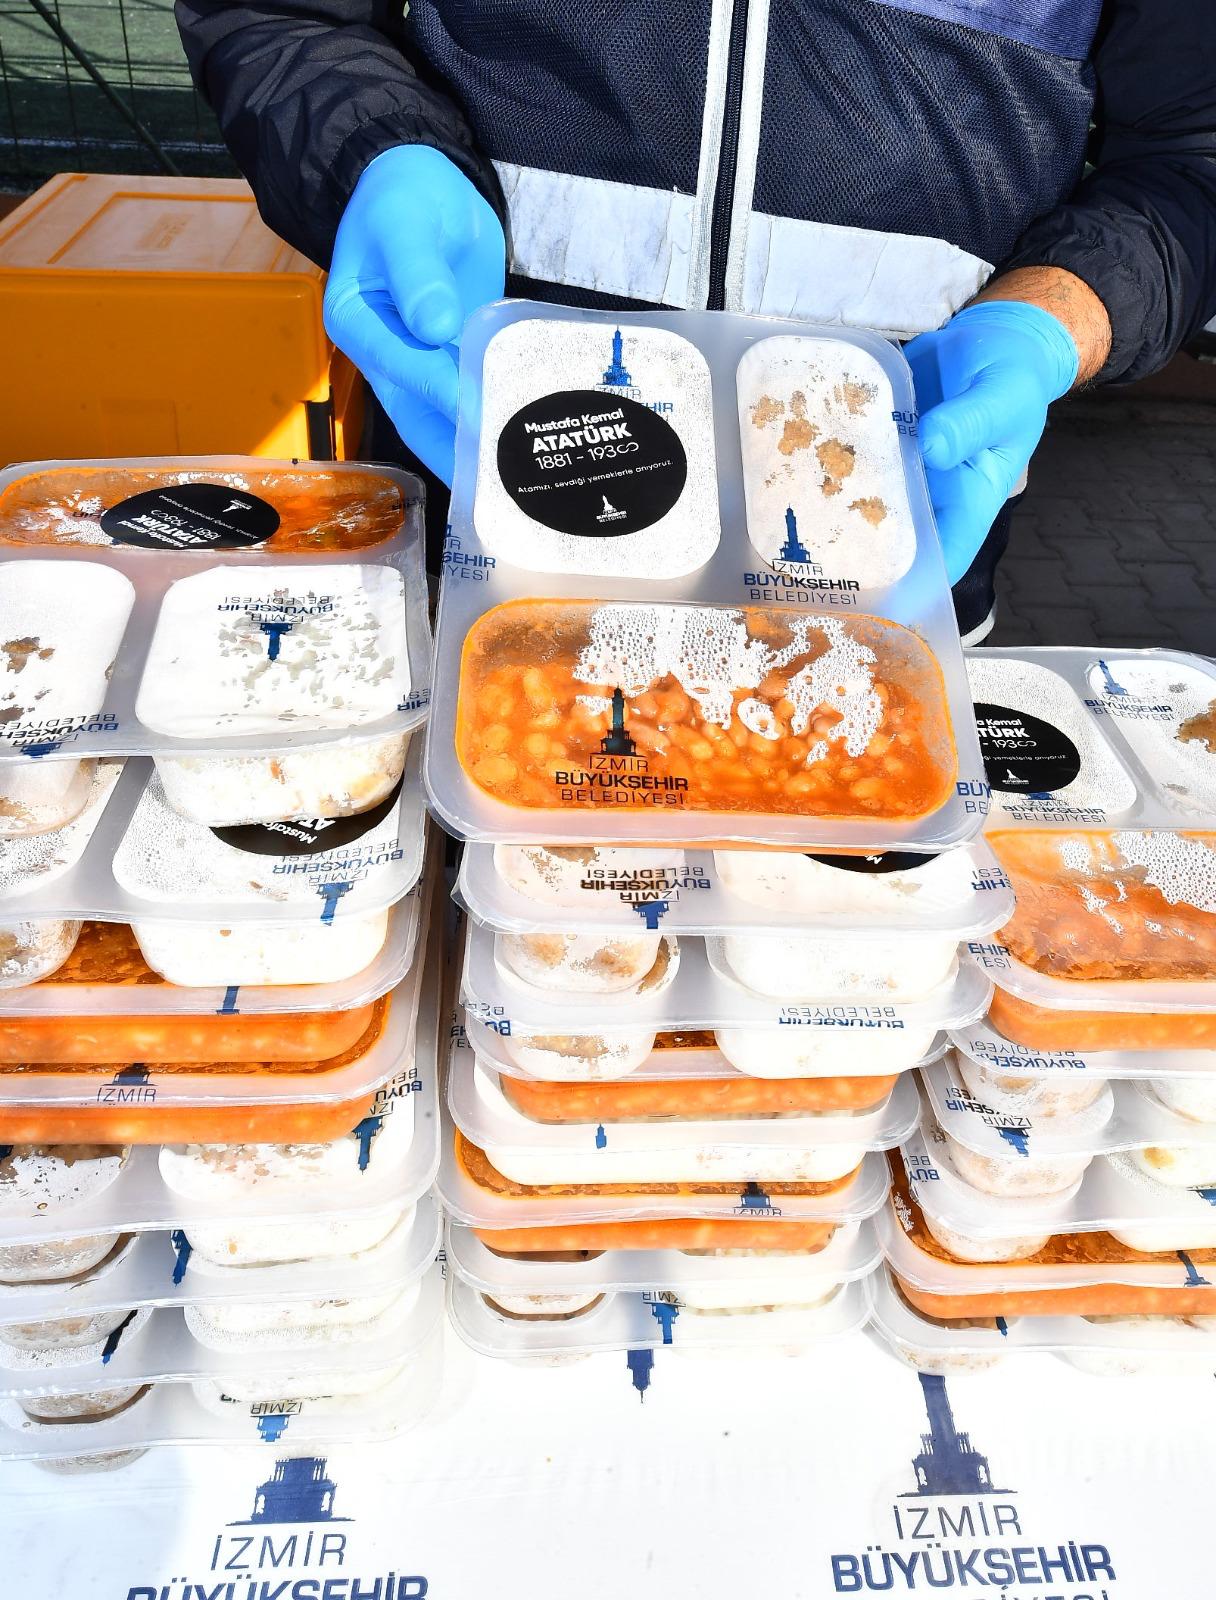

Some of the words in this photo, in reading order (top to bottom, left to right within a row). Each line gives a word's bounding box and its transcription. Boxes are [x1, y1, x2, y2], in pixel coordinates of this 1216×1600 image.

[524, 416, 581, 434] Mustafa
[582, 408, 624, 426] Kemal
[532, 422, 632, 454] ATATÜRK
[534, 452, 573, 470] 1881
[587, 468, 634, 484] yemeklerle
[744, 571, 860, 592] BÜYÜKŞEHİR
[977, 726, 1030, 738] TÜRK
[986, 718, 1022, 726] Kemal
[556, 769, 688, 791] BÜYÜKŞEHİR
[562, 789, 684, 804] BELEDİYESİ
[893, 1502, 1022, 1540] İZMİR
[210, 1531, 347, 1570] İZMİR
[830, 1540, 1116, 1592] BÜYÜKŞEHİR
